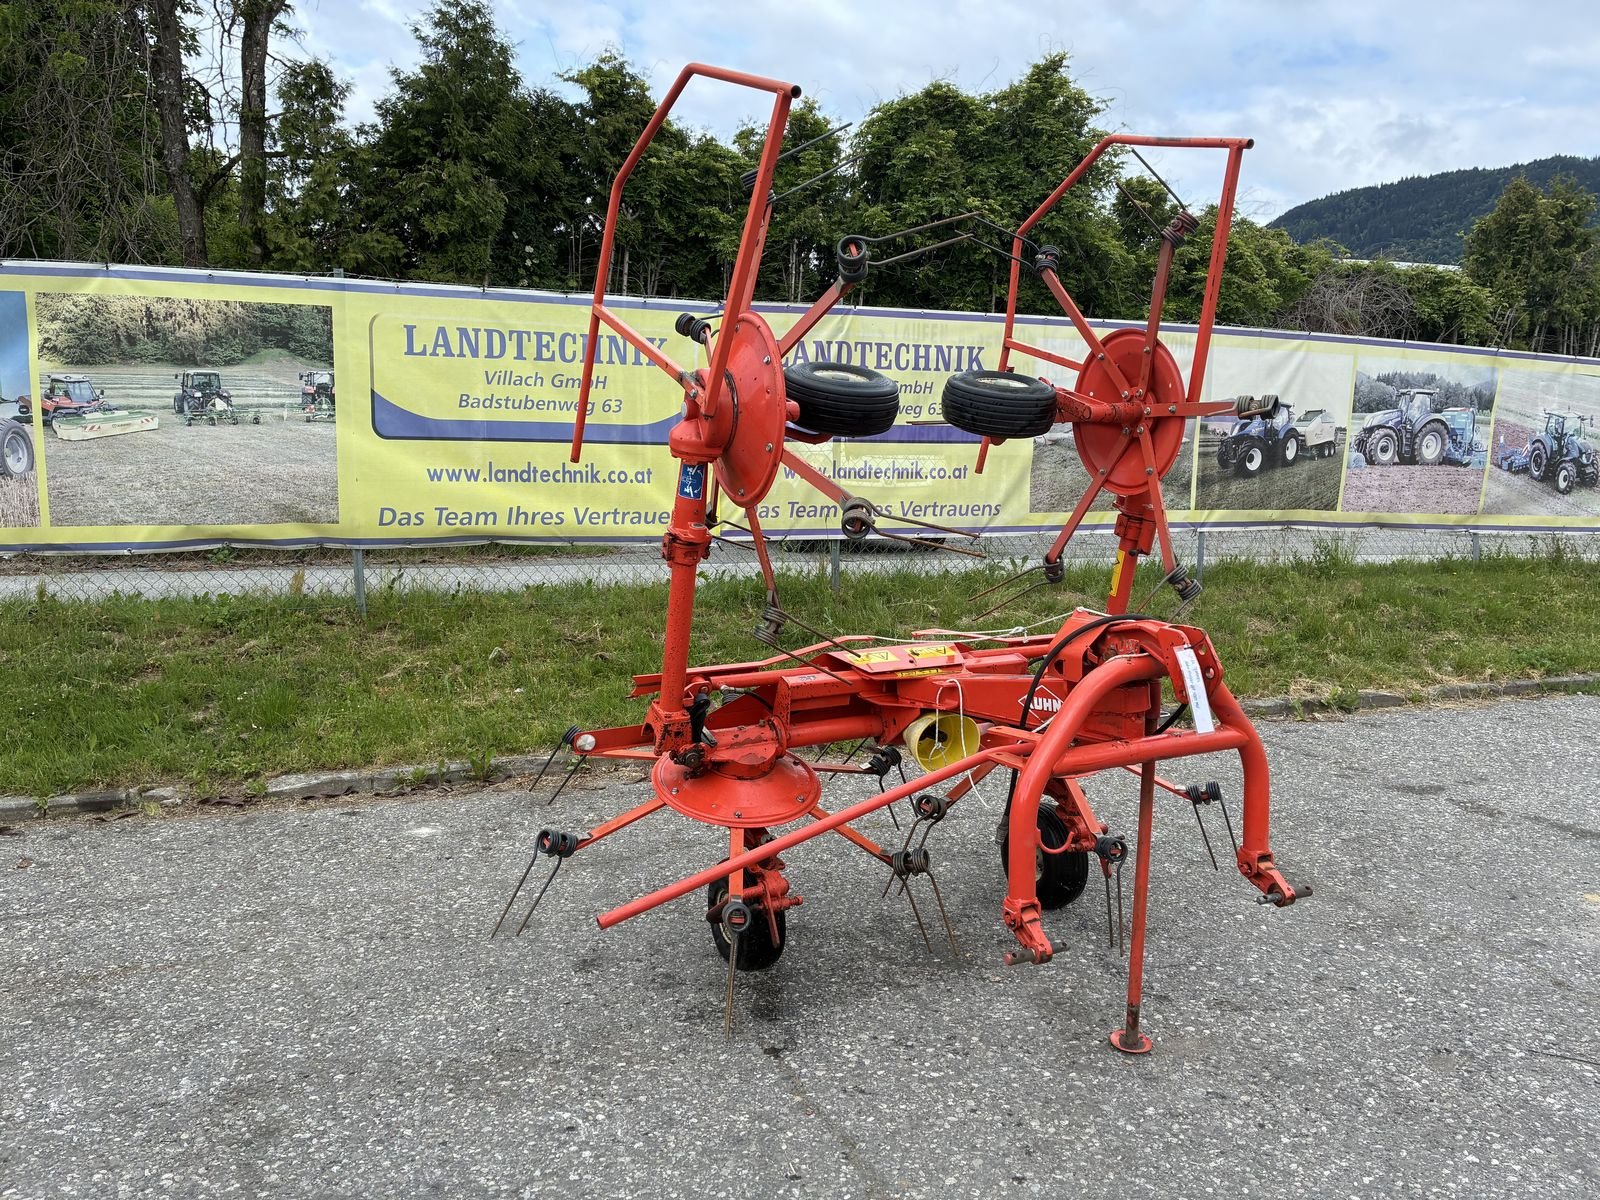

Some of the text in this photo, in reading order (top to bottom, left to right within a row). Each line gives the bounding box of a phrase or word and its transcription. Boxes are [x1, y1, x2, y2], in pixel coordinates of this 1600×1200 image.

[484, 370, 545, 388] Villach
[602, 399, 623, 414] 63
[426, 461, 653, 484] www.landtechnik.co.at
[784, 459, 968, 480] w.landtechnik.co.at
[378, 506, 671, 527] Das Team Ihres Vertraue
[744, 501, 838, 519] as Team
[900, 501, 1002, 517] Vertrauens
